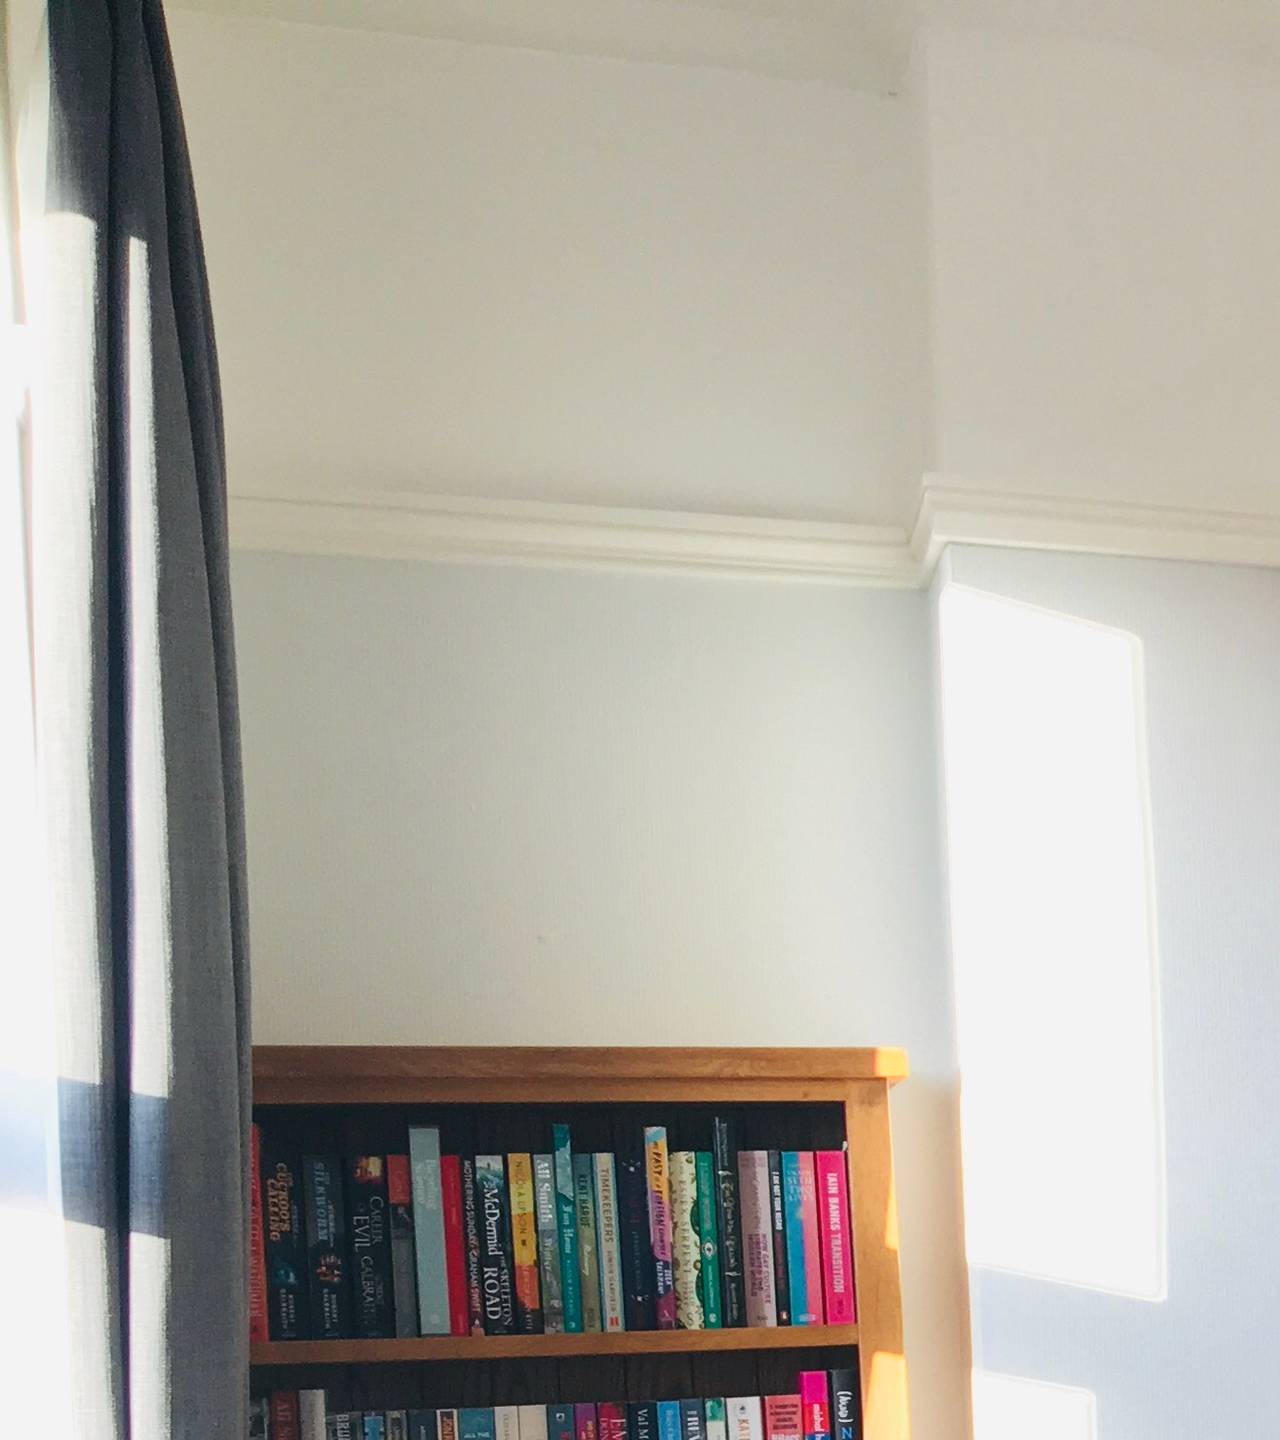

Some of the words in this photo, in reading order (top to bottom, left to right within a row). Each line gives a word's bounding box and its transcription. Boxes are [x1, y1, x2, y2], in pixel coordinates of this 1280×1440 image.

[463, 1160, 476, 1210] MOTHERING
[537, 1160, 551, 1181] Ali
[827, 1172, 839, 1195] IAIN
[267, 1179, 281, 1241] CALLING
[276, 1163, 292, 1232] CUCKOO'S
[540, 1182, 554, 1223] Smith
[562, 1205, 573, 1226] Fun
[600, 1168, 614, 1243] TIMEKEEPERS
[829, 1196, 842, 1231] BANKS
[353, 1216, 371, 1253] EVIL
[482, 1187, 503, 1256] McDermid
[563, 1228, 575, 1255] Home
[469, 1250, 481, 1287] GRAHAM
[831, 1233, 845, 1294] TRANSITION
[471, 1288, 482, 1313] SWIFT
[483, 1267, 502, 1320] ROAD
[637, 1409, 649, 1428] Val
